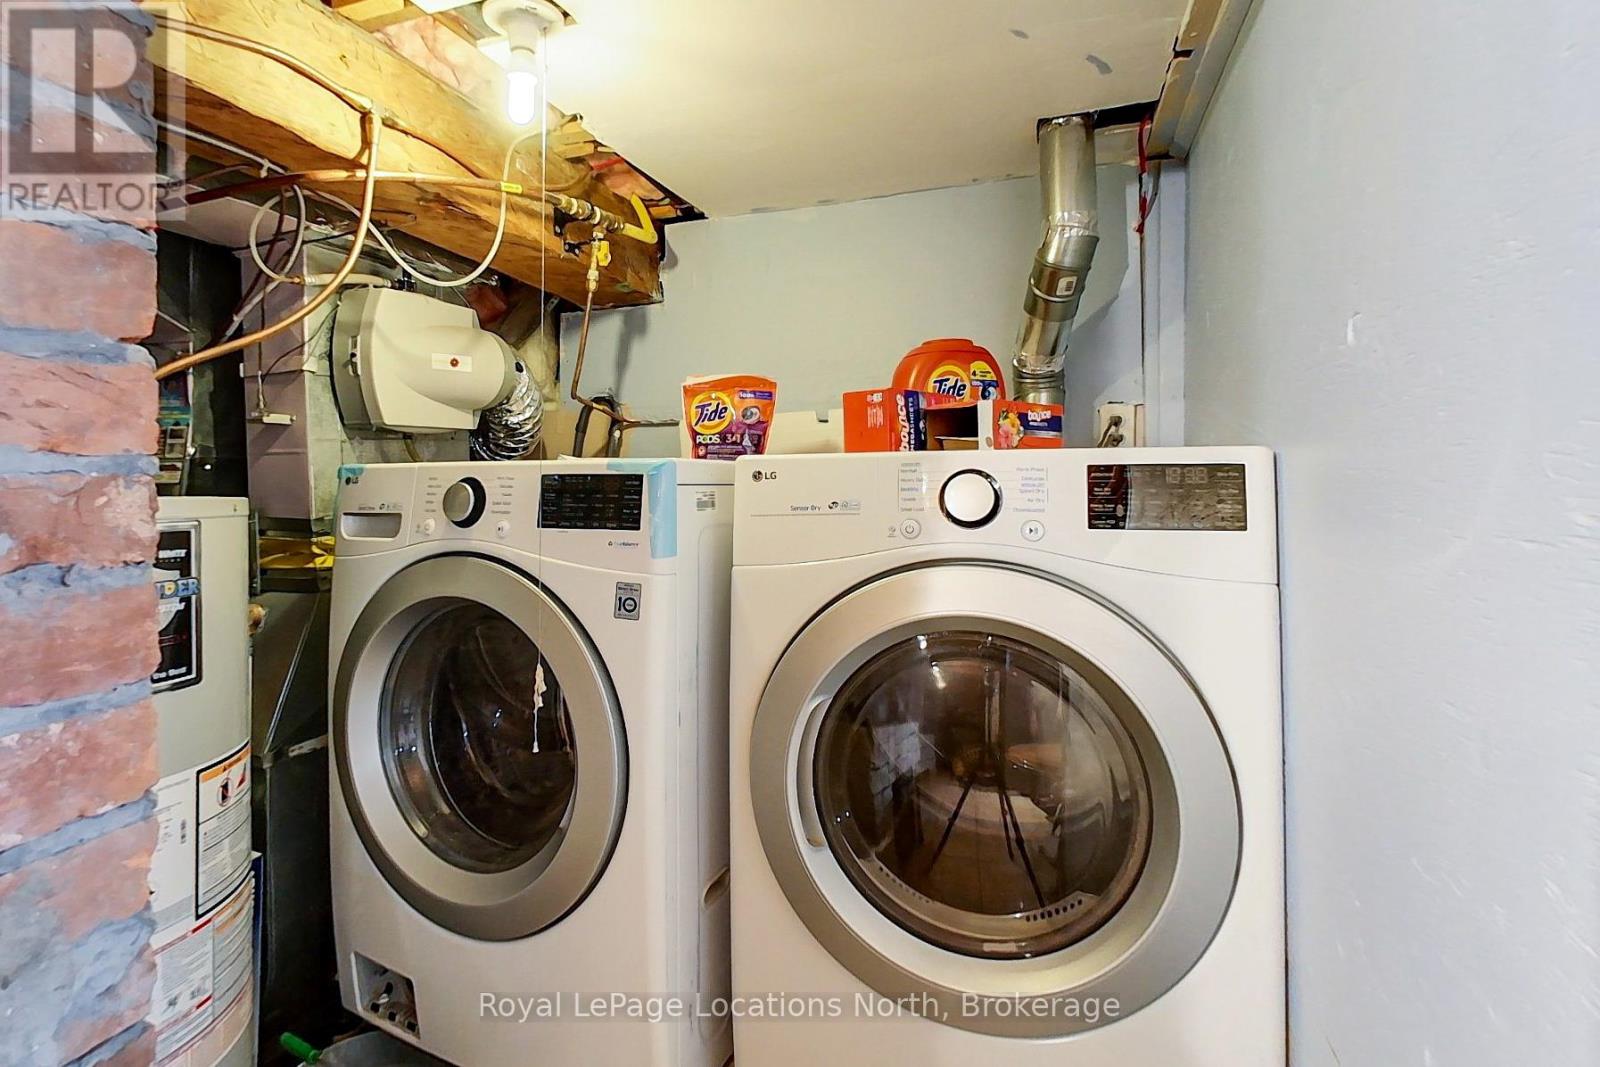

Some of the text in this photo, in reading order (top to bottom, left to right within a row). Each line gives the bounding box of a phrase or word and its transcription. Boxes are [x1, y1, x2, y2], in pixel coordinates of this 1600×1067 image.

[933, 377, 967, 398] Tide
[695, 401, 728, 427] Tide
[896, 393, 910, 451] bounce
[696, 434, 721, 445] PODS
[764, 471, 777, 480] LG
[617, 596, 637, 613] 10
